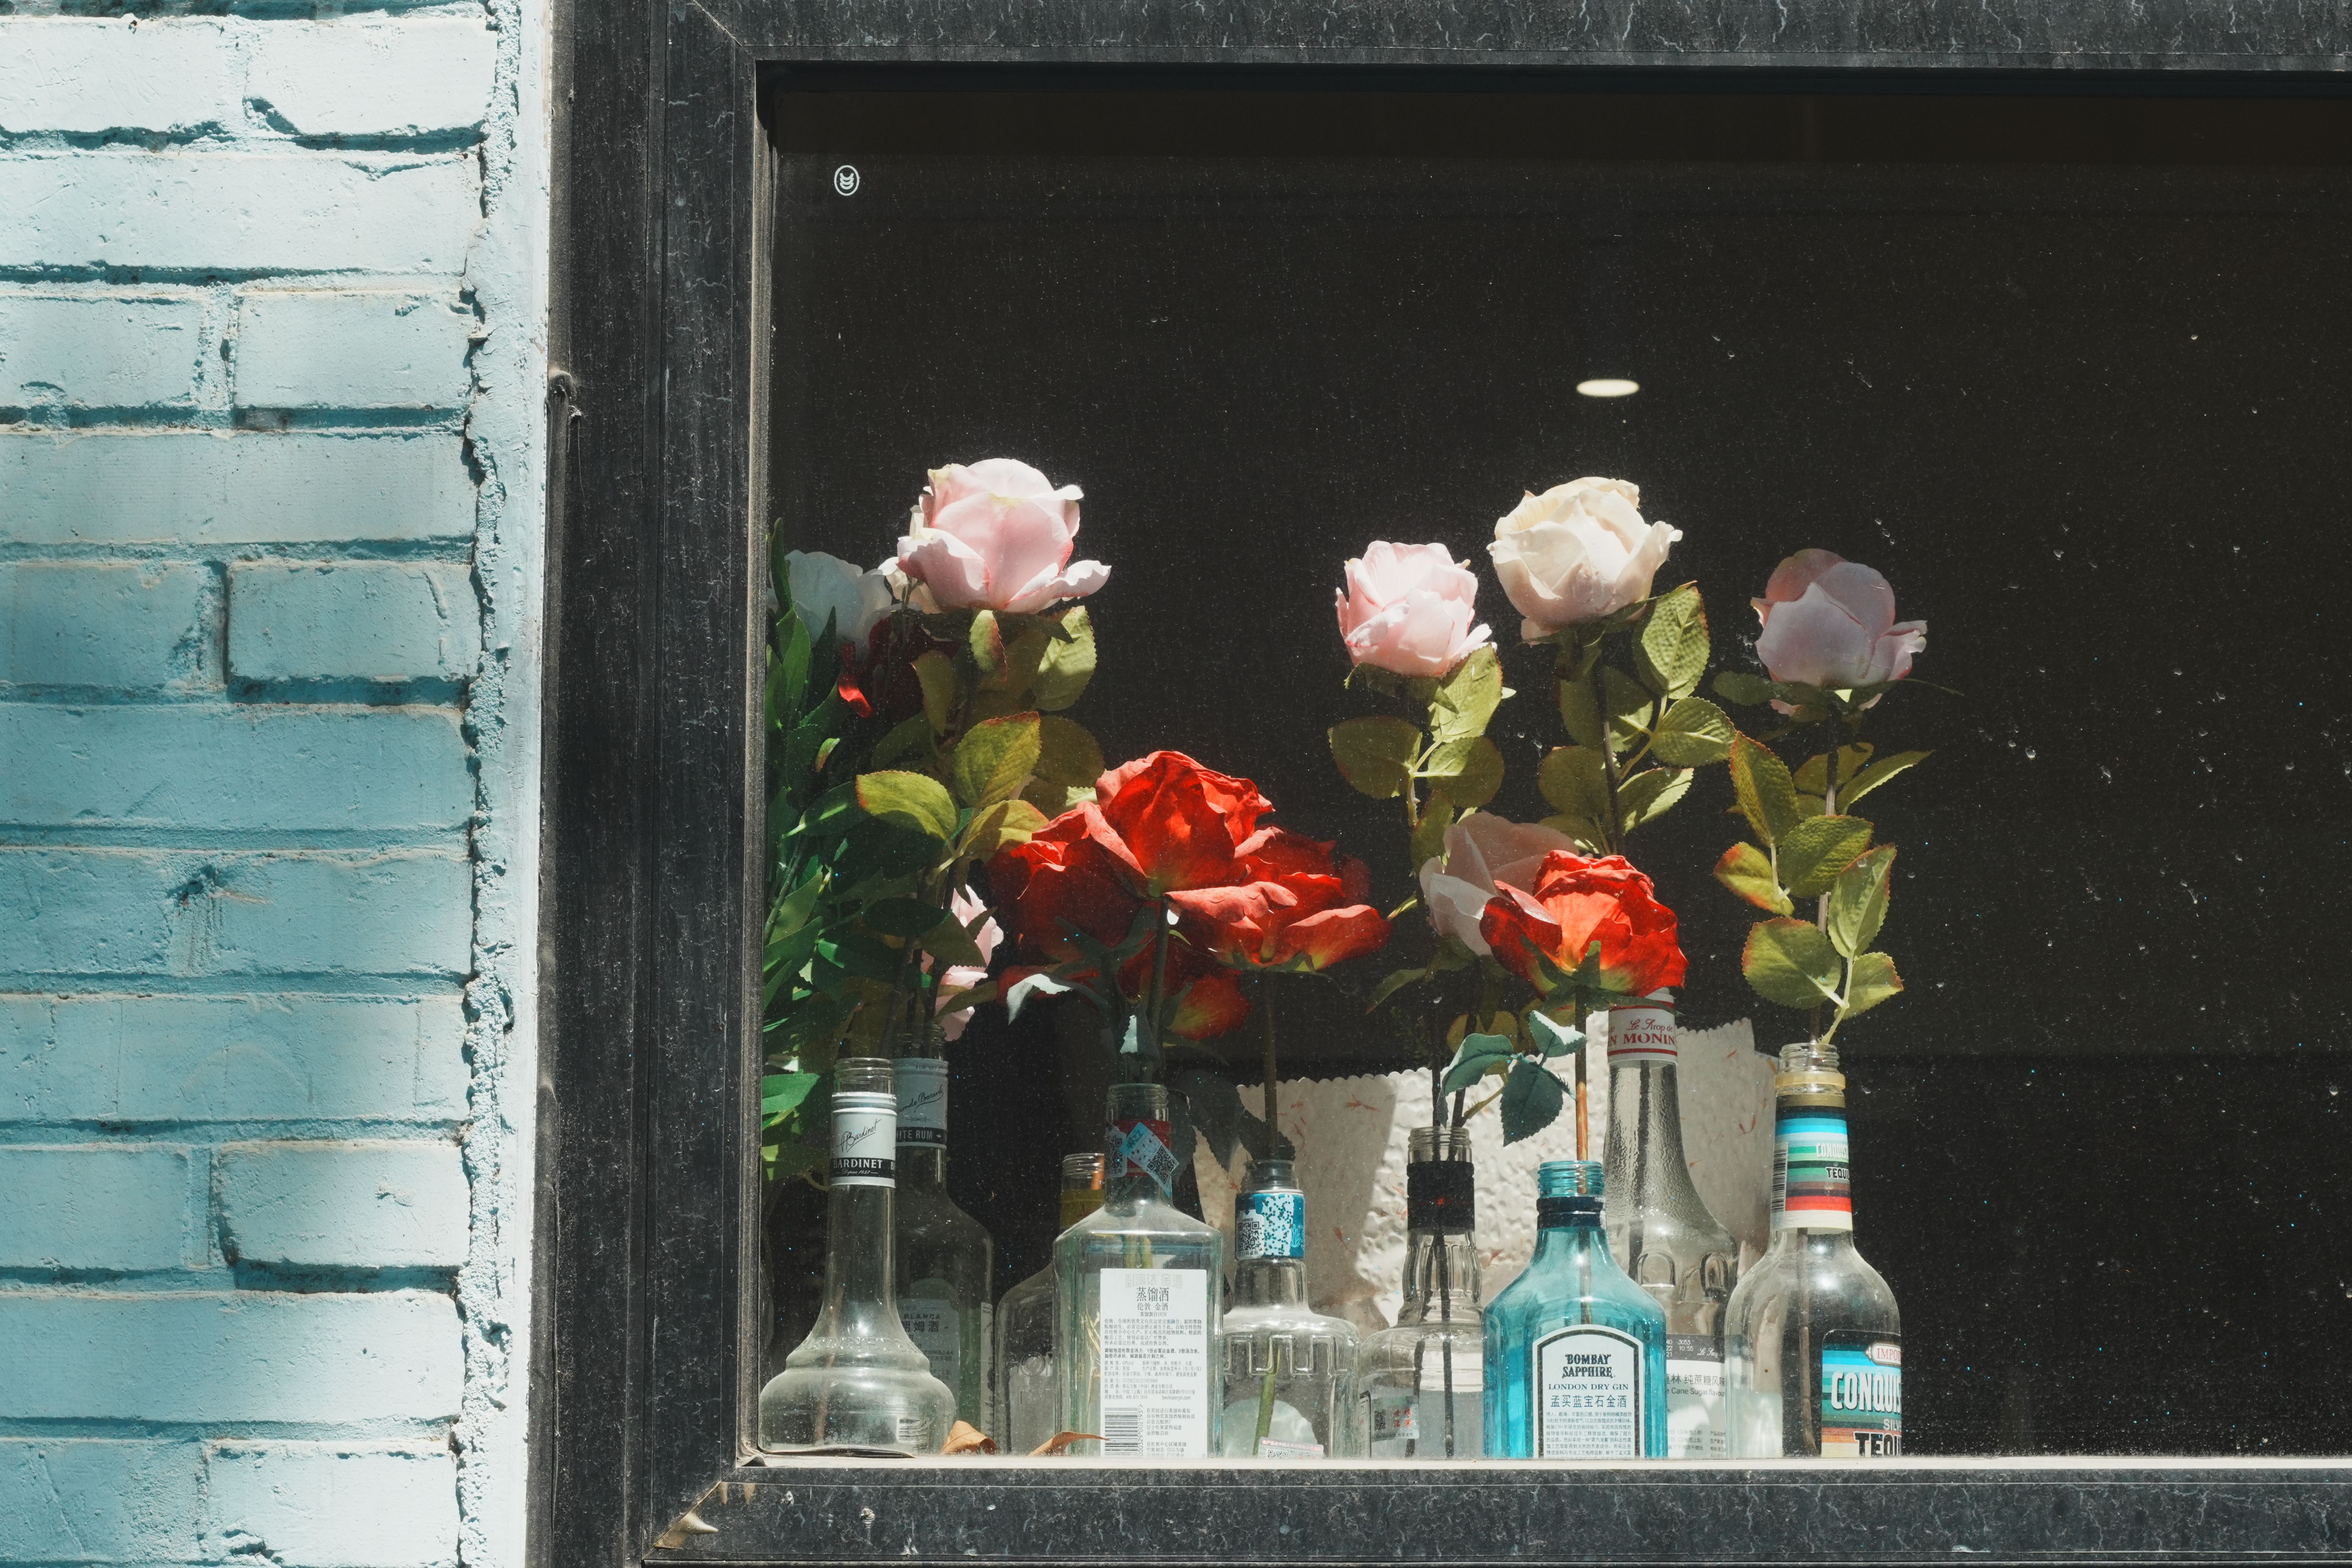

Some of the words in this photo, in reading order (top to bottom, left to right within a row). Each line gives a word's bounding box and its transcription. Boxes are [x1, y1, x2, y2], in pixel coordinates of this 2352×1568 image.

[1626, 1019, 1641, 1031] Le
[1623, 1033, 1675, 1045] MONIN
[916, 1130, 933, 1140] RUM
[833, 1159, 883, 1168] BARDINET
[1161, 1274, 1182, 1289] 金酒
[1136, 1287, 1169, 1302] 蒸馏酒
[1565, 1353, 1612, 1365] BOMBAY
[1562, 1366, 1613, 1379] SAPPHIRE
[1684, 1374, 1725, 1386] 纯蔗糖风味
[1690, 1388, 1707, 1397] Sugar
[1551, 1395, 1627, 1408] 孟买蓝宝石金酒
